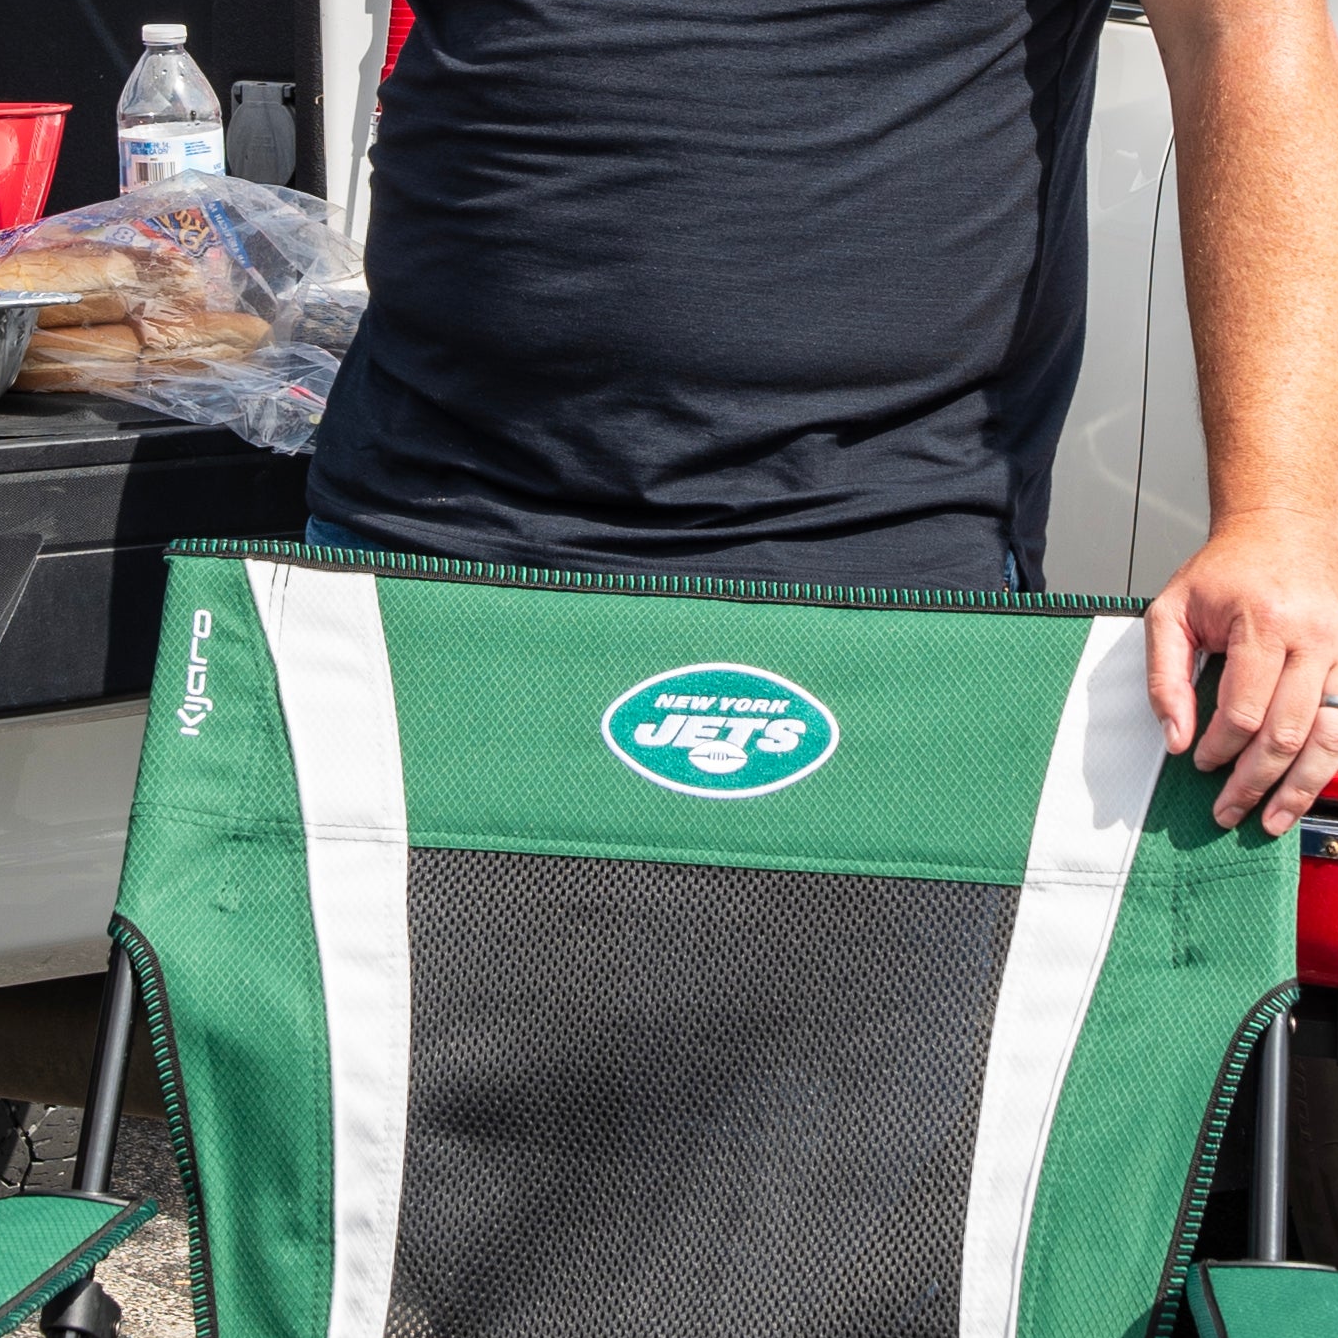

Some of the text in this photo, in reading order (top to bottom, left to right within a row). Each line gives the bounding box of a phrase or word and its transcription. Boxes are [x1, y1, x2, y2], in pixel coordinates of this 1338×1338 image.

[177, 609, 213, 736] Kijaro
[655, 693, 790, 714] NEW YORK
[633, 713, 807, 753] JETS
